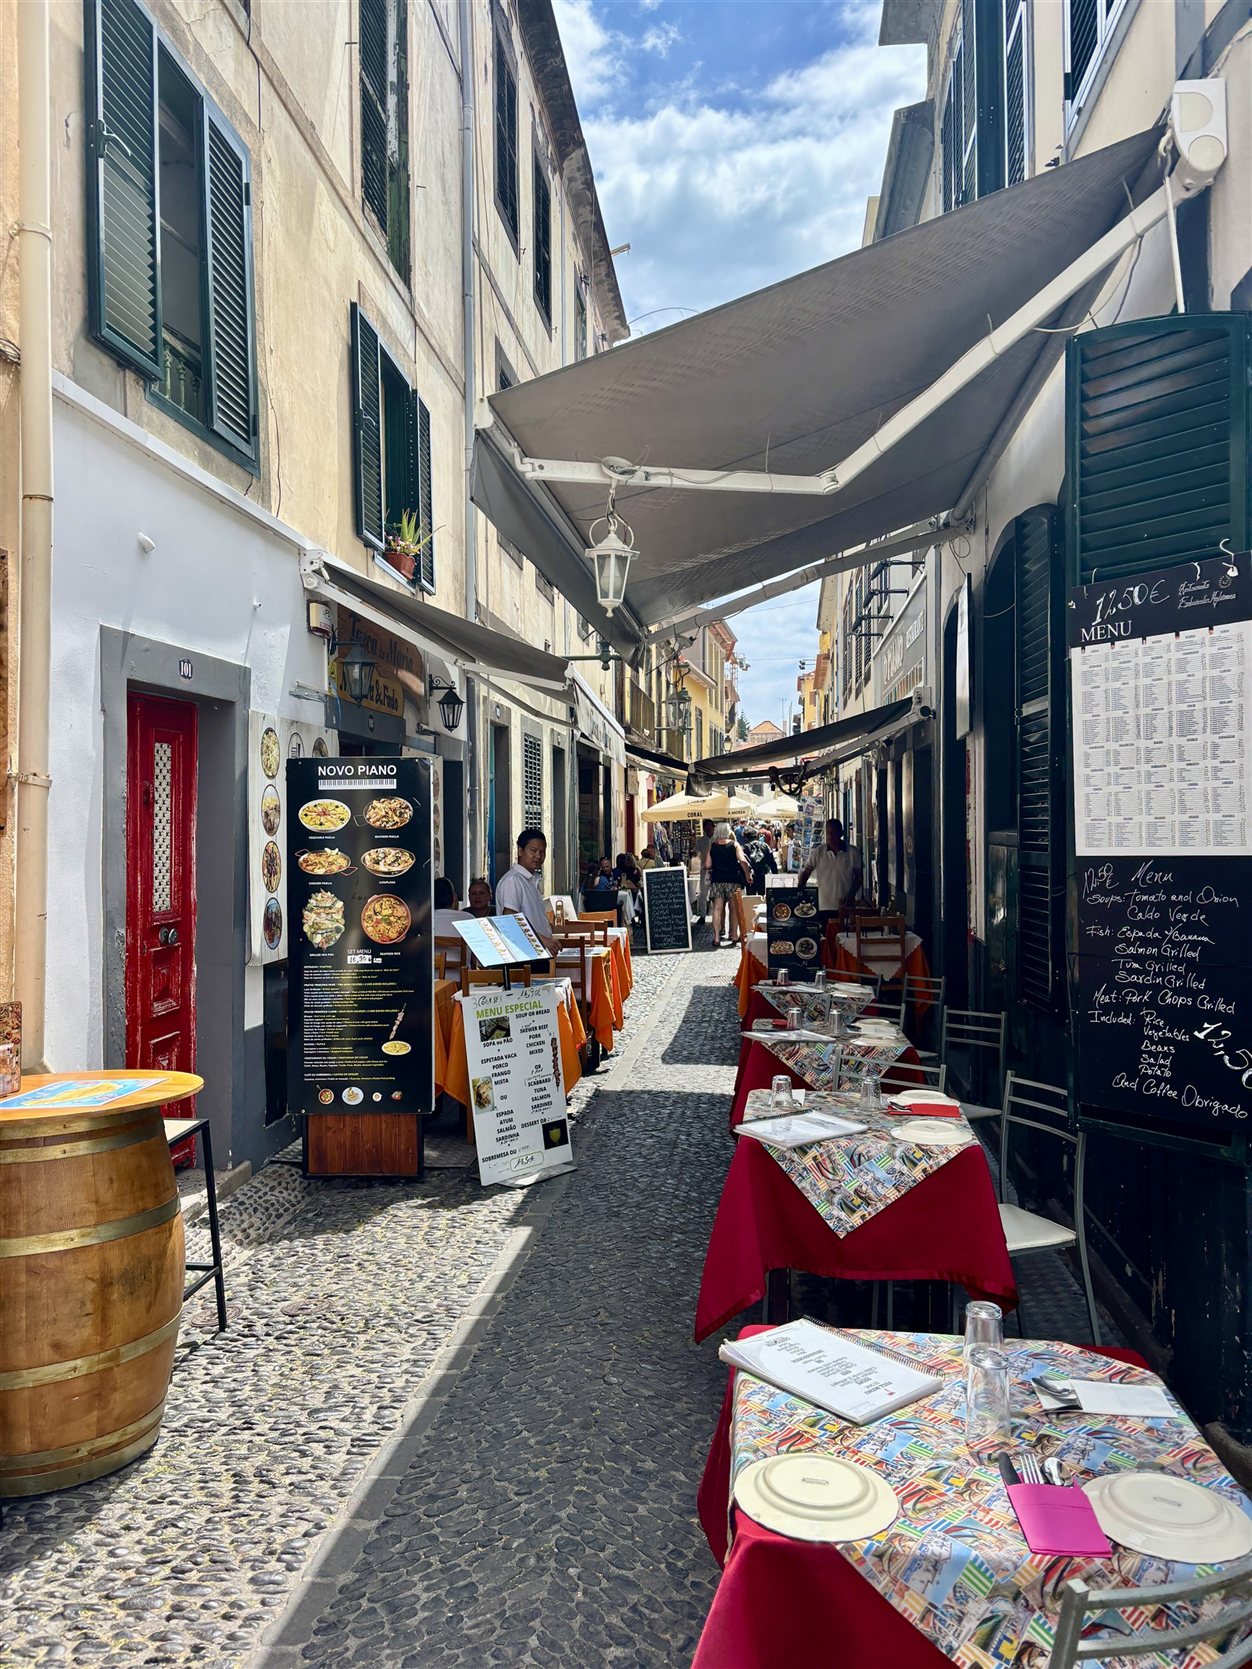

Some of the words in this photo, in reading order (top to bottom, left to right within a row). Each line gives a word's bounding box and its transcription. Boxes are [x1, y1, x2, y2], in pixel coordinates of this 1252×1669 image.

[1080, 620, 1132, 643] MENU
[181, 662, 192, 677] 101
[318, 765, 354, 776] NOVO
[357, 765, 397, 776] PIANO
[1131, 860, 1174, 888] Menu
[1087, 894, 1125, 908] Soups:
[1125, 889, 1167, 906] Tomato
[1170, 891, 1193, 904] and
[1196, 885, 1239, 907] Onion
[1127, 905, 1161, 920] Caldo
[1169, 905, 1209, 926] Verde
[1086, 925, 1115, 937] Fish:
[1117, 926, 1162, 941] Espada
[1115, 942, 1158, 956] Salmon
[1160, 944, 1201, 962] Grilled
[1145, 960, 1185, 975] Grilled
[1164, 973, 1206, 989] Grilled
[1093, 984, 1122, 1008] Meat:
[1122, 989, 1152, 1004] Pork
[1158, 989, 1192, 1007] Chops
[1197, 995, 1235, 1014] Grilled
[476, 1006, 503, 1019] MENU
[505, 1000, 544, 1014] ESPECIAL
[1088, 1010, 1136, 1025] Included:
[1140, 1007, 1165, 1027] Rice
[1143, 1027, 1190, 1041] Vegetables
[526, 1040, 545, 1048] CHICKEN
[1141, 1040, 1175, 1053] Beans
[480, 1055, 504, 1064] ESPETADA
[492, 1062, 509, 1070] PORCO
[1140, 1054, 1173, 1067] Salad
[491, 1069, 511, 1078] FRANGO
[1139, 1065, 1172, 1077] Potato
[494, 1078, 509, 1086] MISTA
[531, 1093, 551, 1102] SALMON
[1142, 1079, 1178, 1099] Coffee
[1181, 1084, 1248, 1119] Obrigado
[531, 1100, 553, 1110] SARDINES
[496, 1109, 514, 1118] ESPADA
[499, 1117, 514, 1125] ATUM
[521, 1119, 540, 1128] DESSERT
[496, 1124, 517, 1134] SALMÃO
[495, 1132, 520, 1143] SARDINHA
[482, 1151, 509, 1163] SOBREMESA
